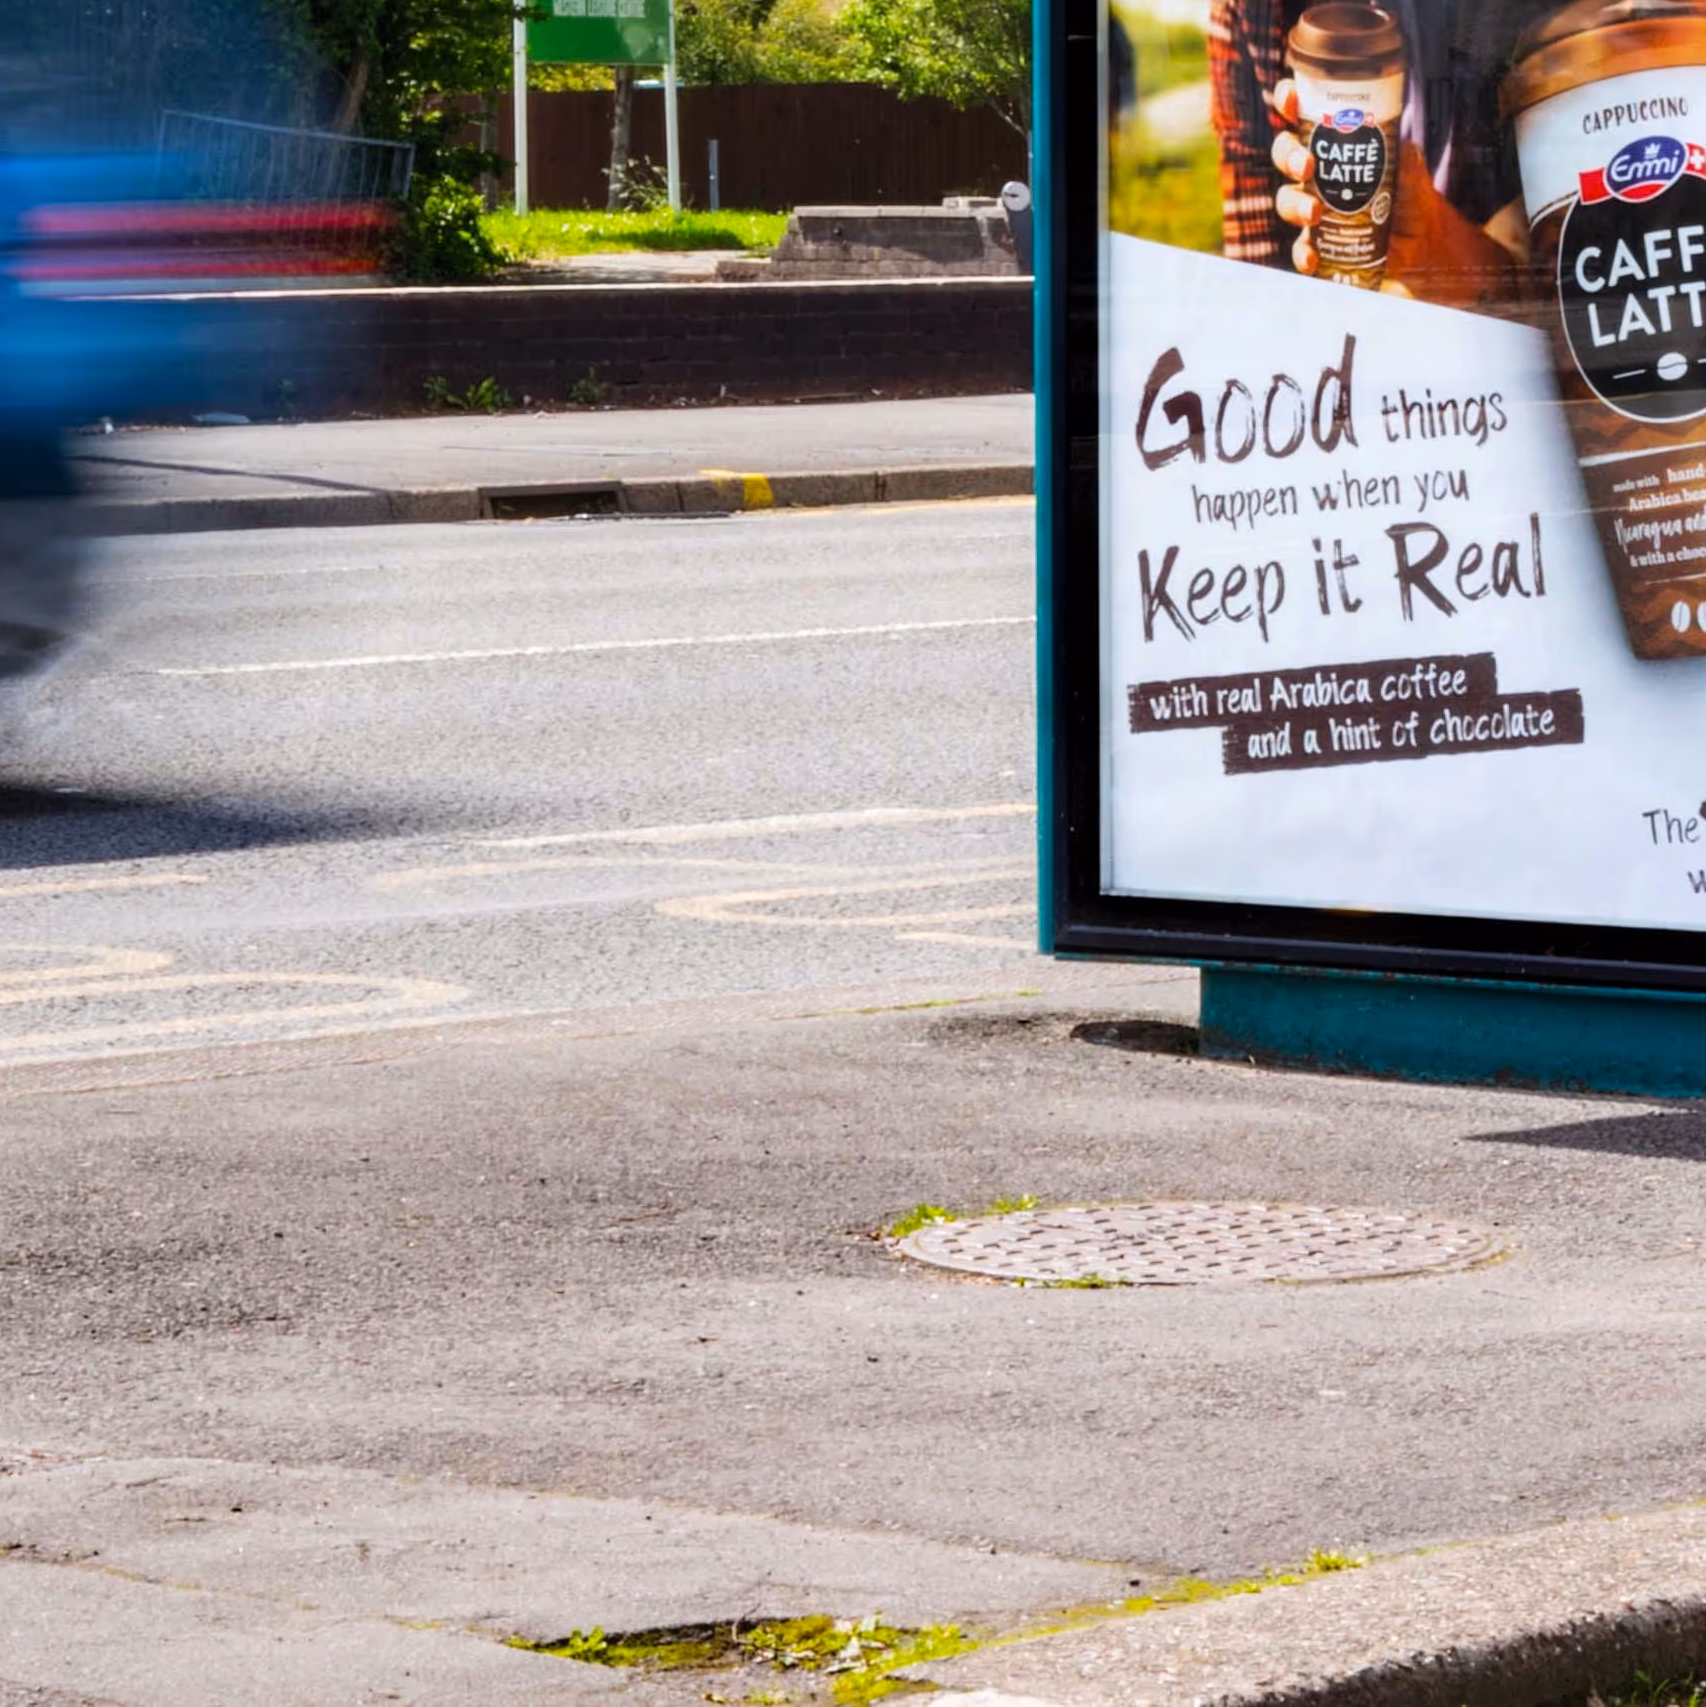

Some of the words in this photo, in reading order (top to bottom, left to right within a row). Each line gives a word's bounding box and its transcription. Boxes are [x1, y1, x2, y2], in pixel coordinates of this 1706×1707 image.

[1582, 96, 1689, 134] CAPPUCCINO
[1315, 138, 1379, 162] CAFFÈ
[1611, 151, 1680, 183] Emmi
[1318, 162, 1375, 183] LATTE
[1135, 333, 1358, 472] Good
[1380, 388, 1508, 447] things
[1191, 483, 1299, 530] happen
[1312, 468, 1401, 511] when
[1416, 468, 1470, 513] you
[1629, 492, 1681, 512] Arabica
[1638, 550, 1665, 566] with
[1666, 553, 1675, 563] a
[1137, 544, 1286, 644] Keep
[1313, 536, 1364, 616] it
[1385, 511, 1547, 622] Real
[1149, 684, 1208, 721] with
[1216, 679, 1261, 714] real
[1269, 667, 1372, 711] Arabica
[1380, 665, 1467, 701] coffee
[1247, 722, 1291, 759] and
[1303, 729, 1322, 754] a
[1329, 717, 1381, 751] hint
[1392, 712, 1419, 747] of
[1429, 705, 1557, 744] chocolate
[1642, 809, 1700, 845] The
